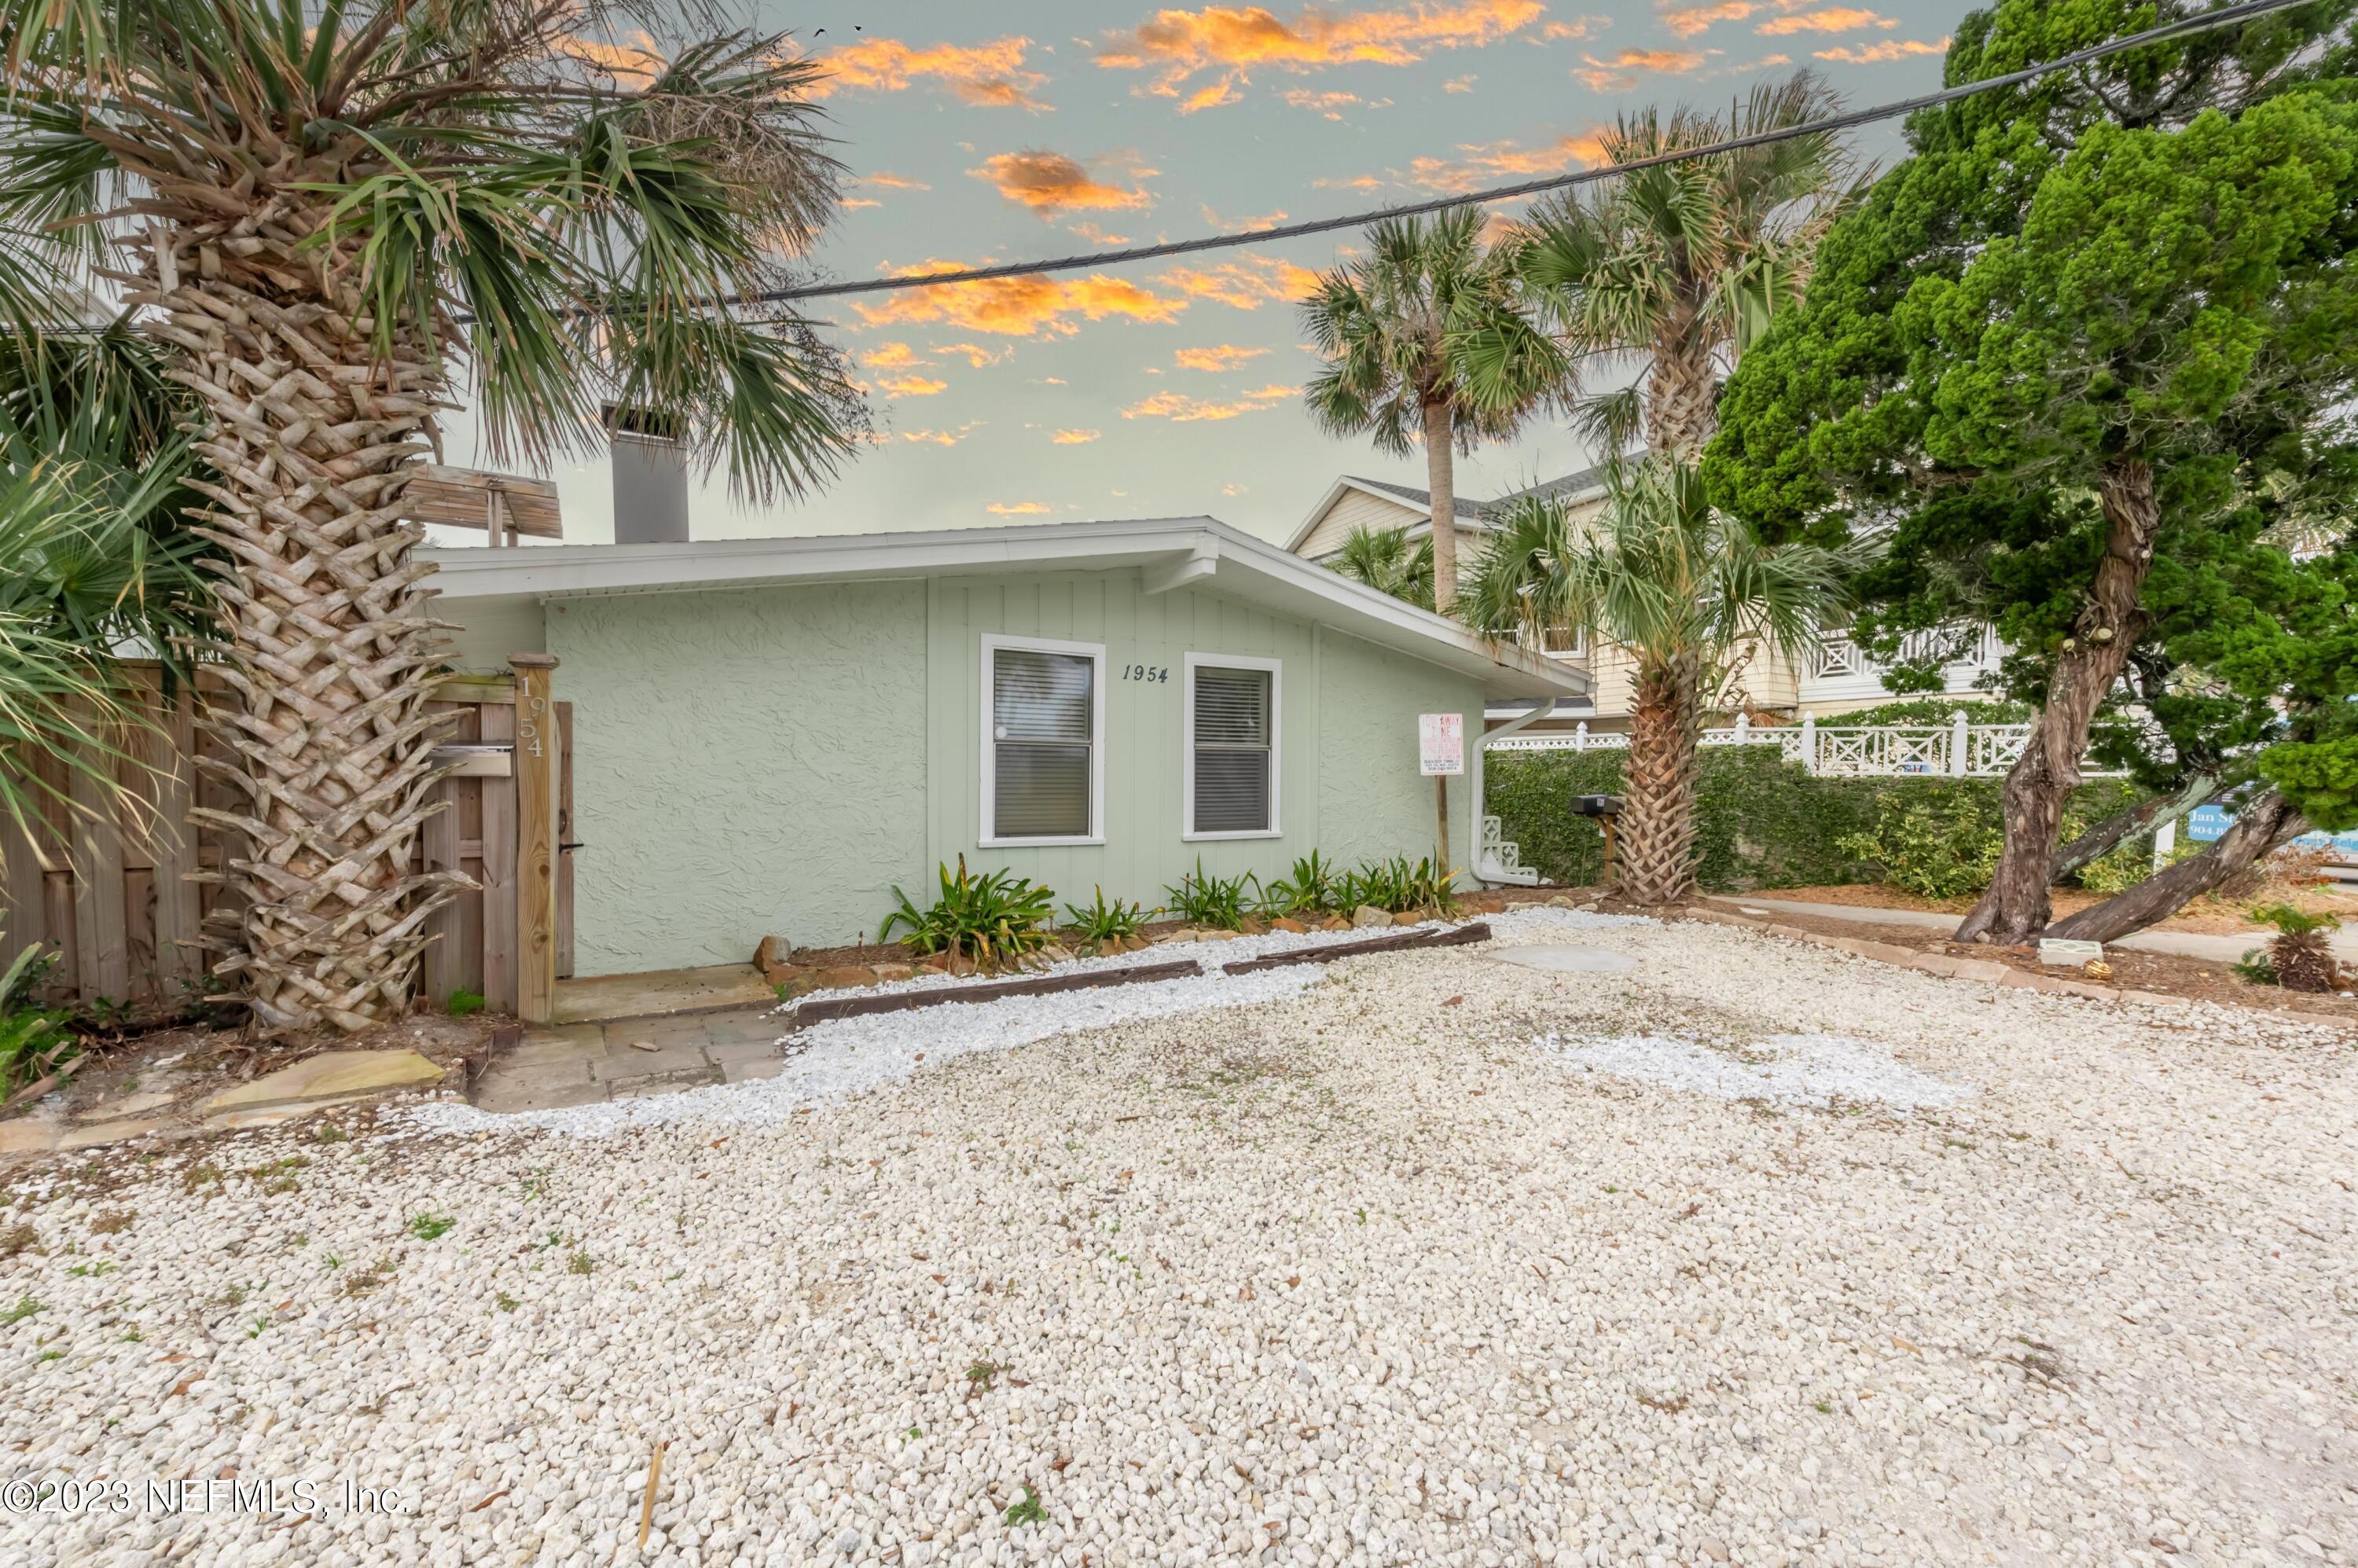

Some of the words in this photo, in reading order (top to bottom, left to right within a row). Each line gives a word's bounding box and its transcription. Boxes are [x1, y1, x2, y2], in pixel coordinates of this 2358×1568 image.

[1123, 664, 1168, 683] 1954
[520, 676, 546, 758] 1954
[1440, 715, 1460, 726] AWAY
[1431, 726, 1451, 737] ZNE
[2190, 810, 2214, 822] Jan
[2190, 825, 2228, 835] 904.8
